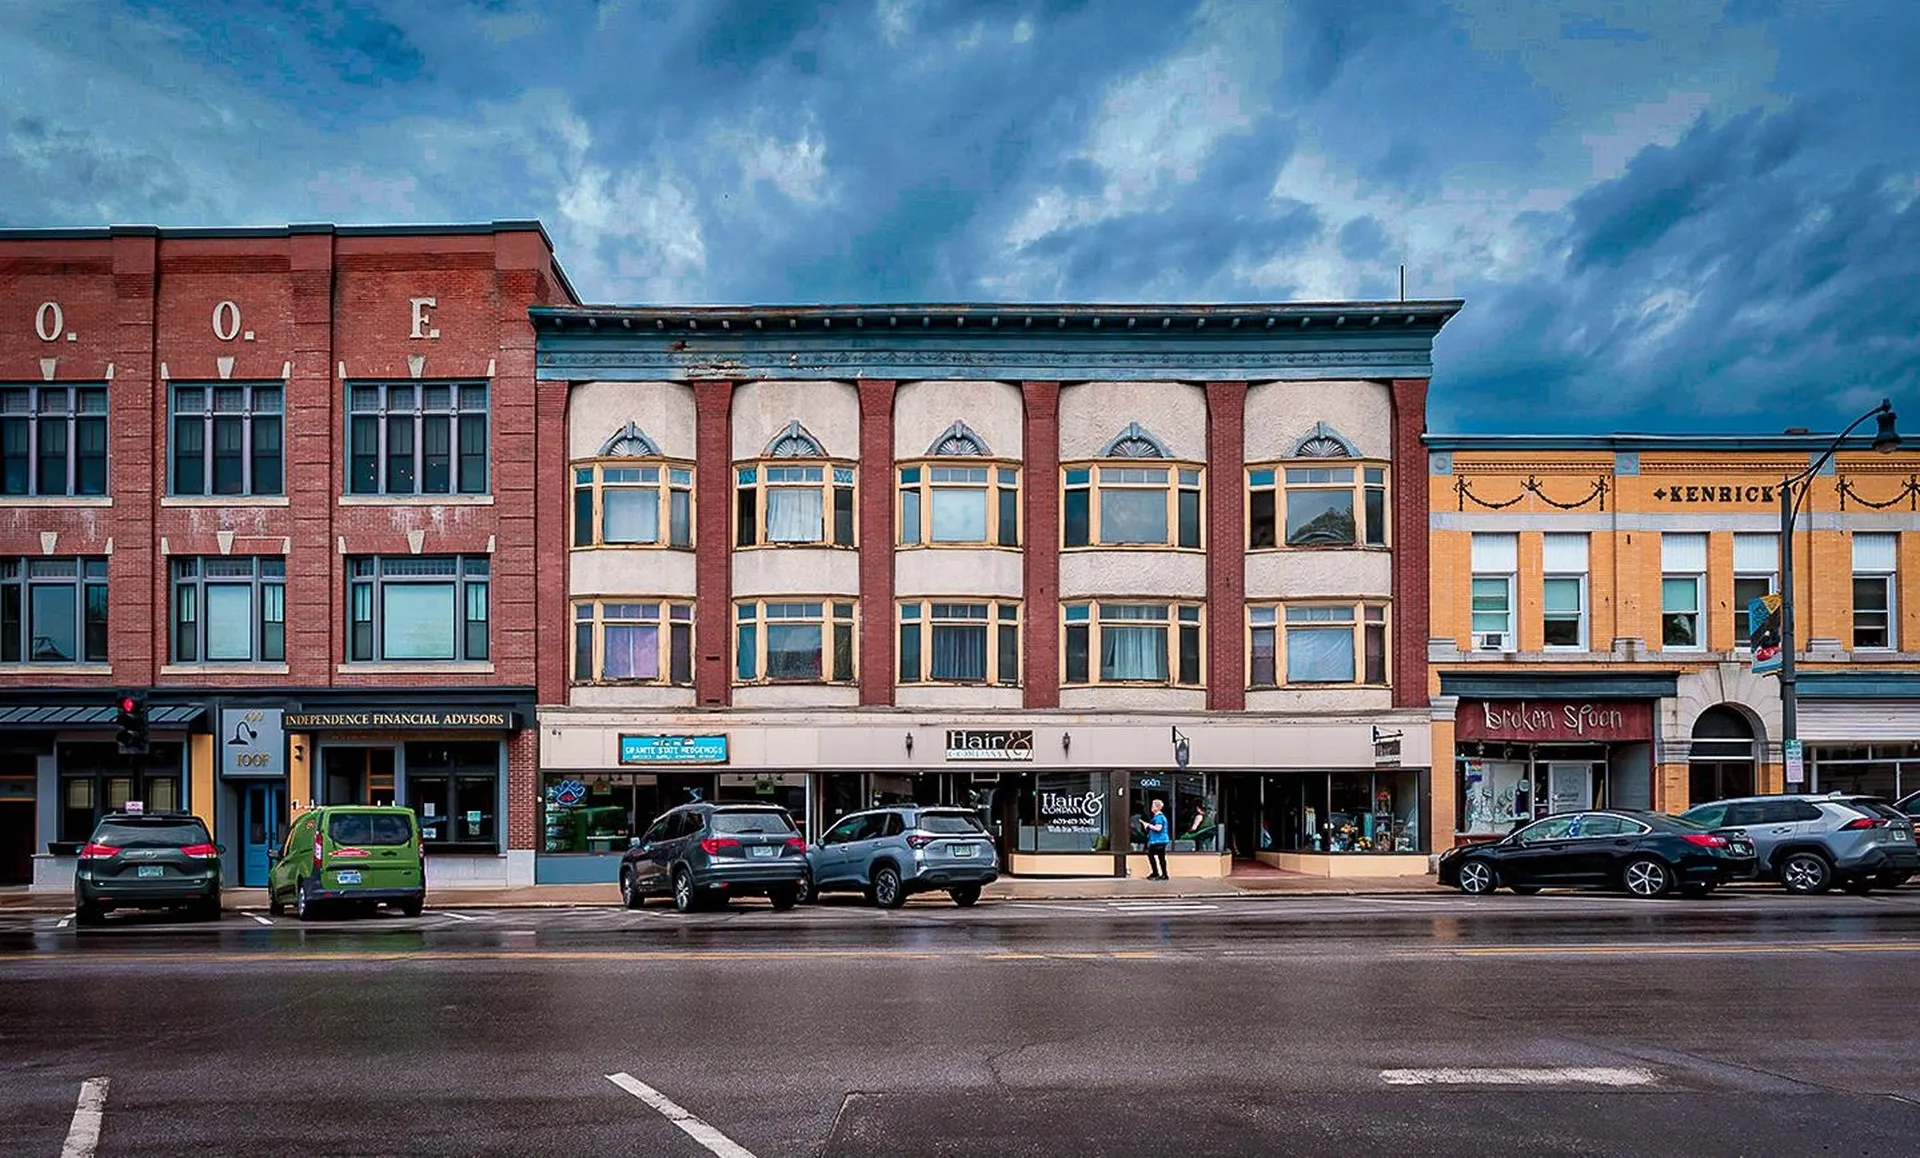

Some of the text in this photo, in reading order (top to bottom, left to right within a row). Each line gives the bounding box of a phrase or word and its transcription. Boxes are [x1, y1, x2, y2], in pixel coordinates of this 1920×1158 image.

[35, 301, 77, 342] O.
[212, 300, 255, 341] O.
[1670, 486, 1774, 503] KENRICK
[286, 714, 504, 726] INDEPENDENCE FINANCIAL ADVISORS
[1483, 702, 1555, 732] broken
[949, 730, 1005, 750] Hair
[1042, 793, 1082, 807] Hair
[1041, 806, 1082, 815] COMPANY
